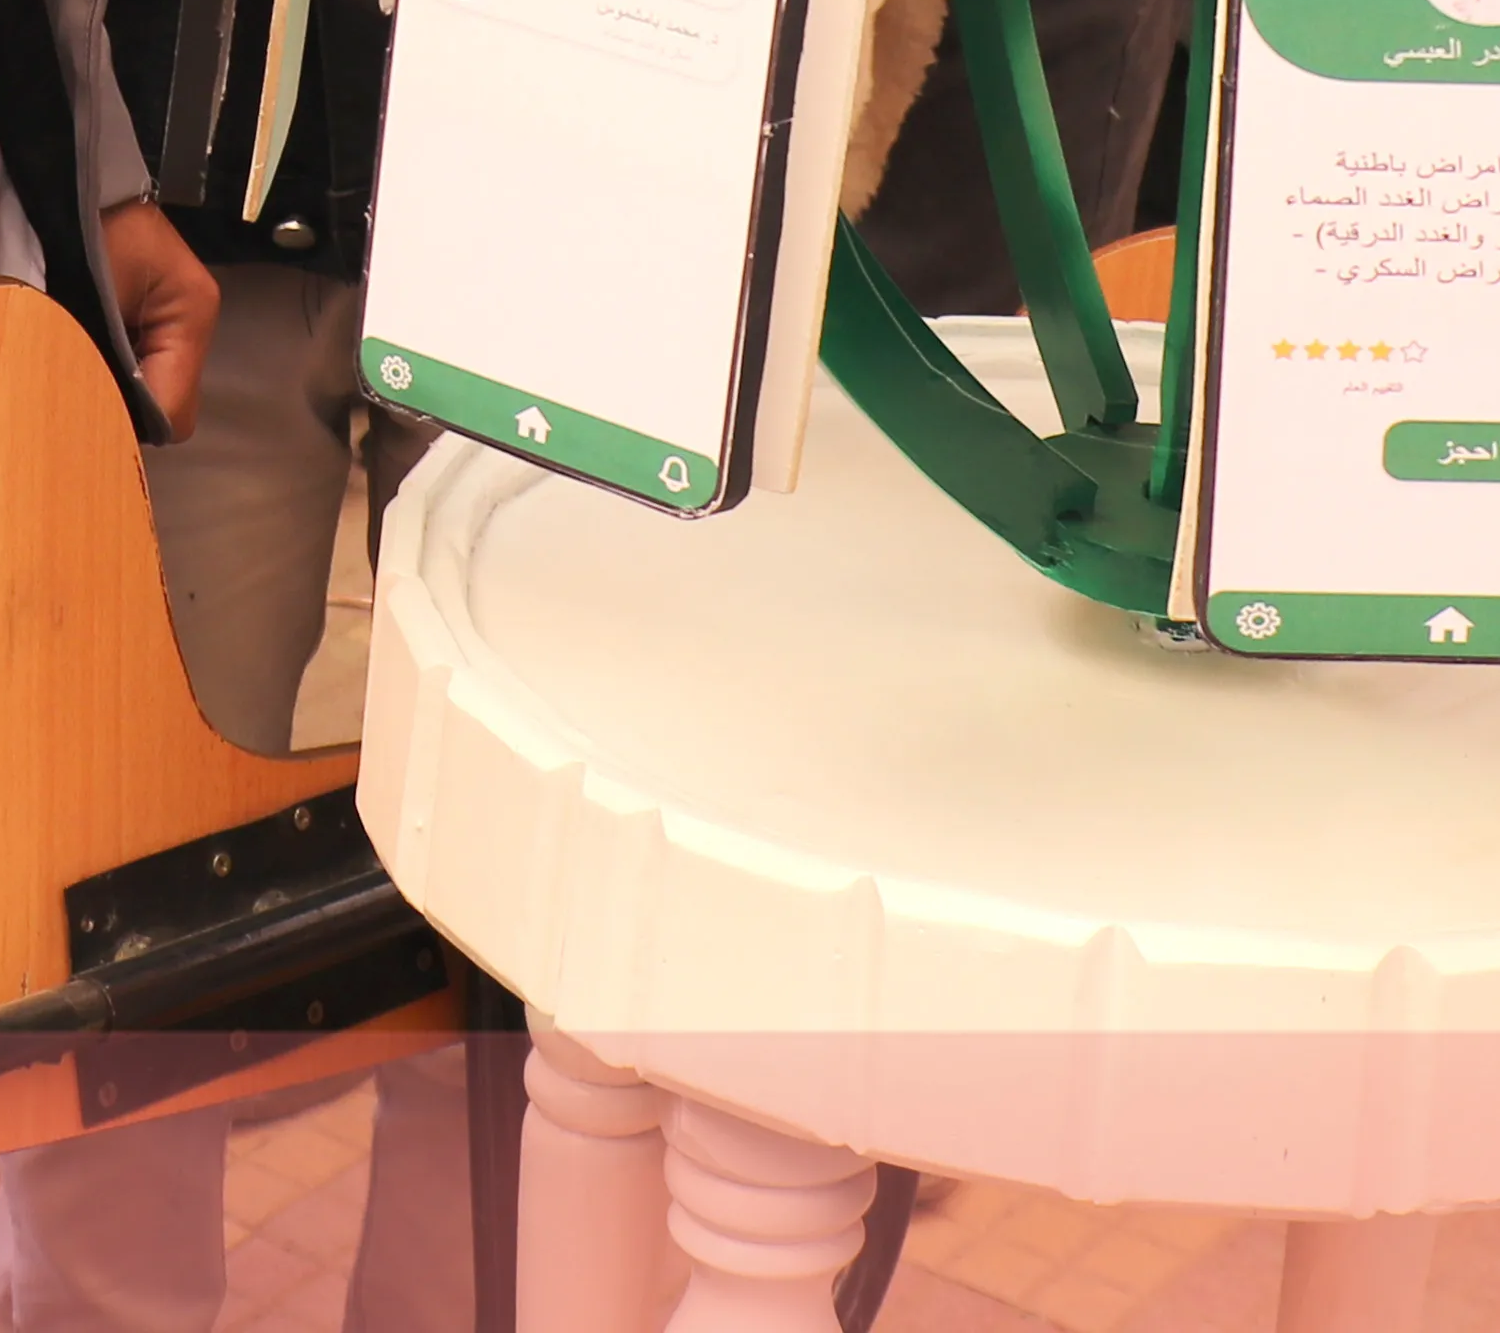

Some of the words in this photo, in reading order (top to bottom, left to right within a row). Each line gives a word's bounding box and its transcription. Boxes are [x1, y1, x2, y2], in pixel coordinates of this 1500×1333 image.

[666, 21, 701, 41] محمد
[1382, 36, 1463, 69] العبسي
[1334, 151, 1407, 179] باطنية
[1285, 185, 1368, 209] الصماء
[1378, 187, 1432, 209] الغدد
[1415, 223, 1485, 250] والغدد
[1336, 257, 1427, 285] السكري
[1436, 440, 1499, 465] احجز
